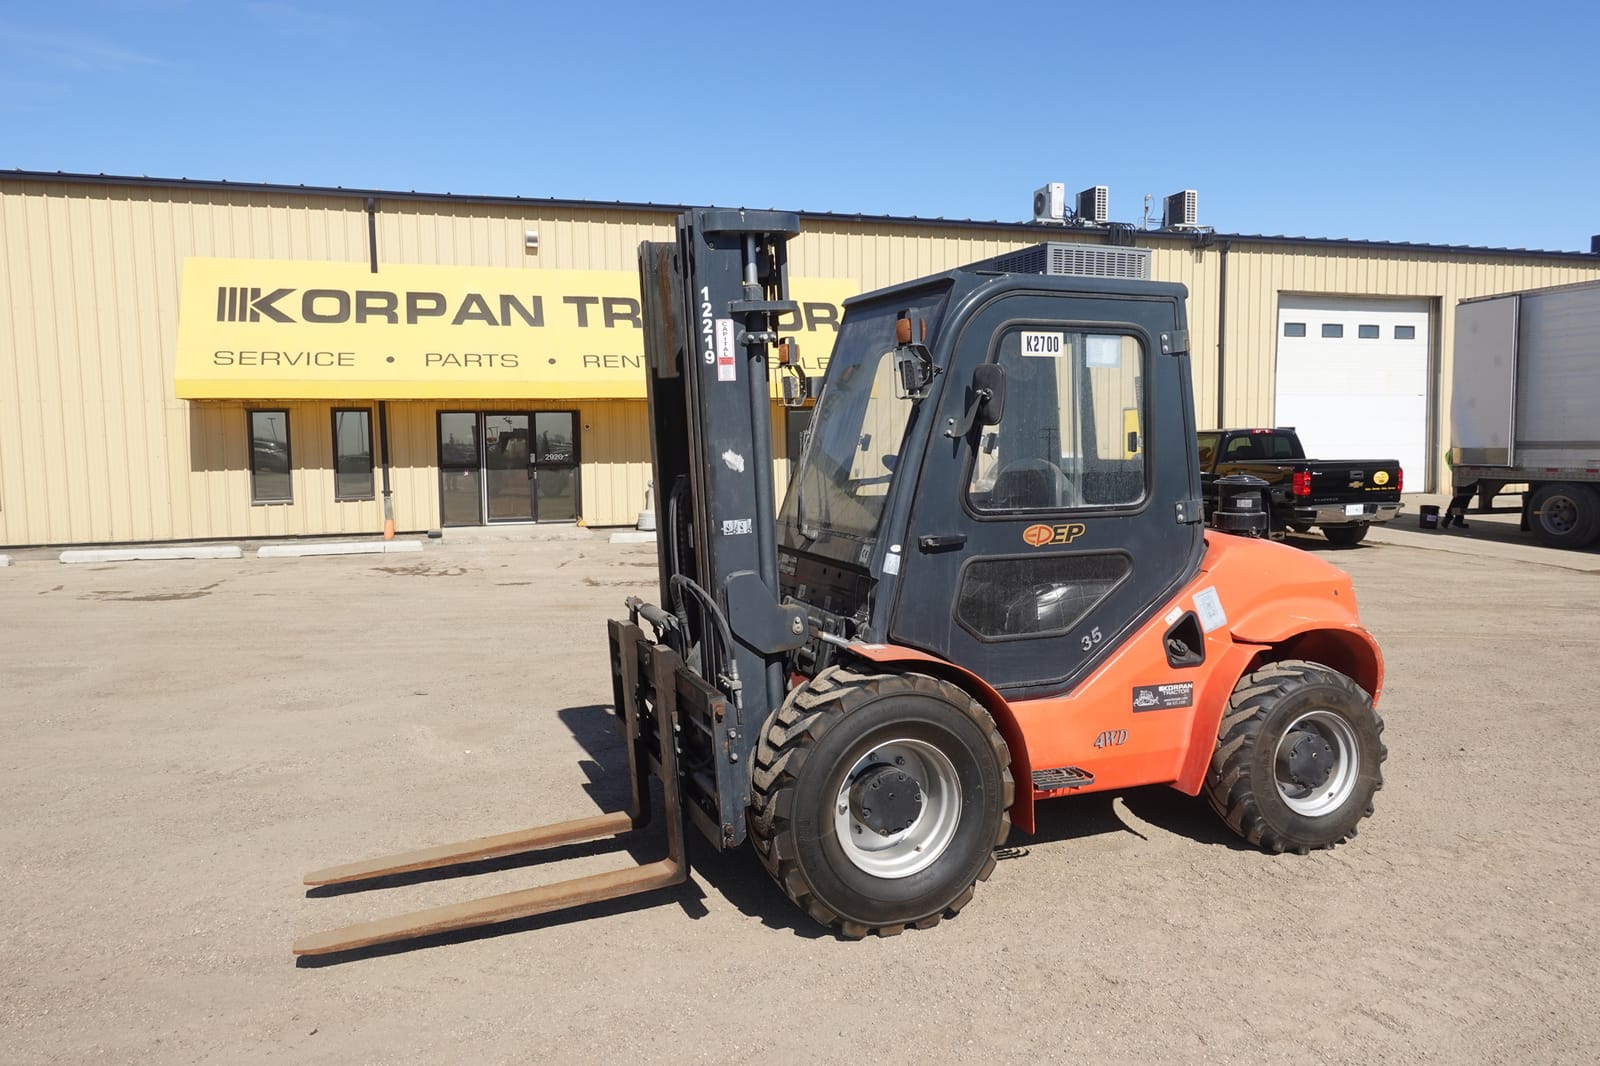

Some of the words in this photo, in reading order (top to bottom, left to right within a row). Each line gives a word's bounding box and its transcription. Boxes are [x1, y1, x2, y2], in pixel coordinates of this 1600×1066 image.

[217, 287, 545, 327] KORPAN
[700, 286, 715, 364] 12219
[1026, 335, 1059, 352] K2700
[213, 351, 355, 367] SERVICE
[425, 353, 519, 368] PARTS
[1081, 626, 1102, 651] 35
[1094, 729, 1128, 748] 4WD
